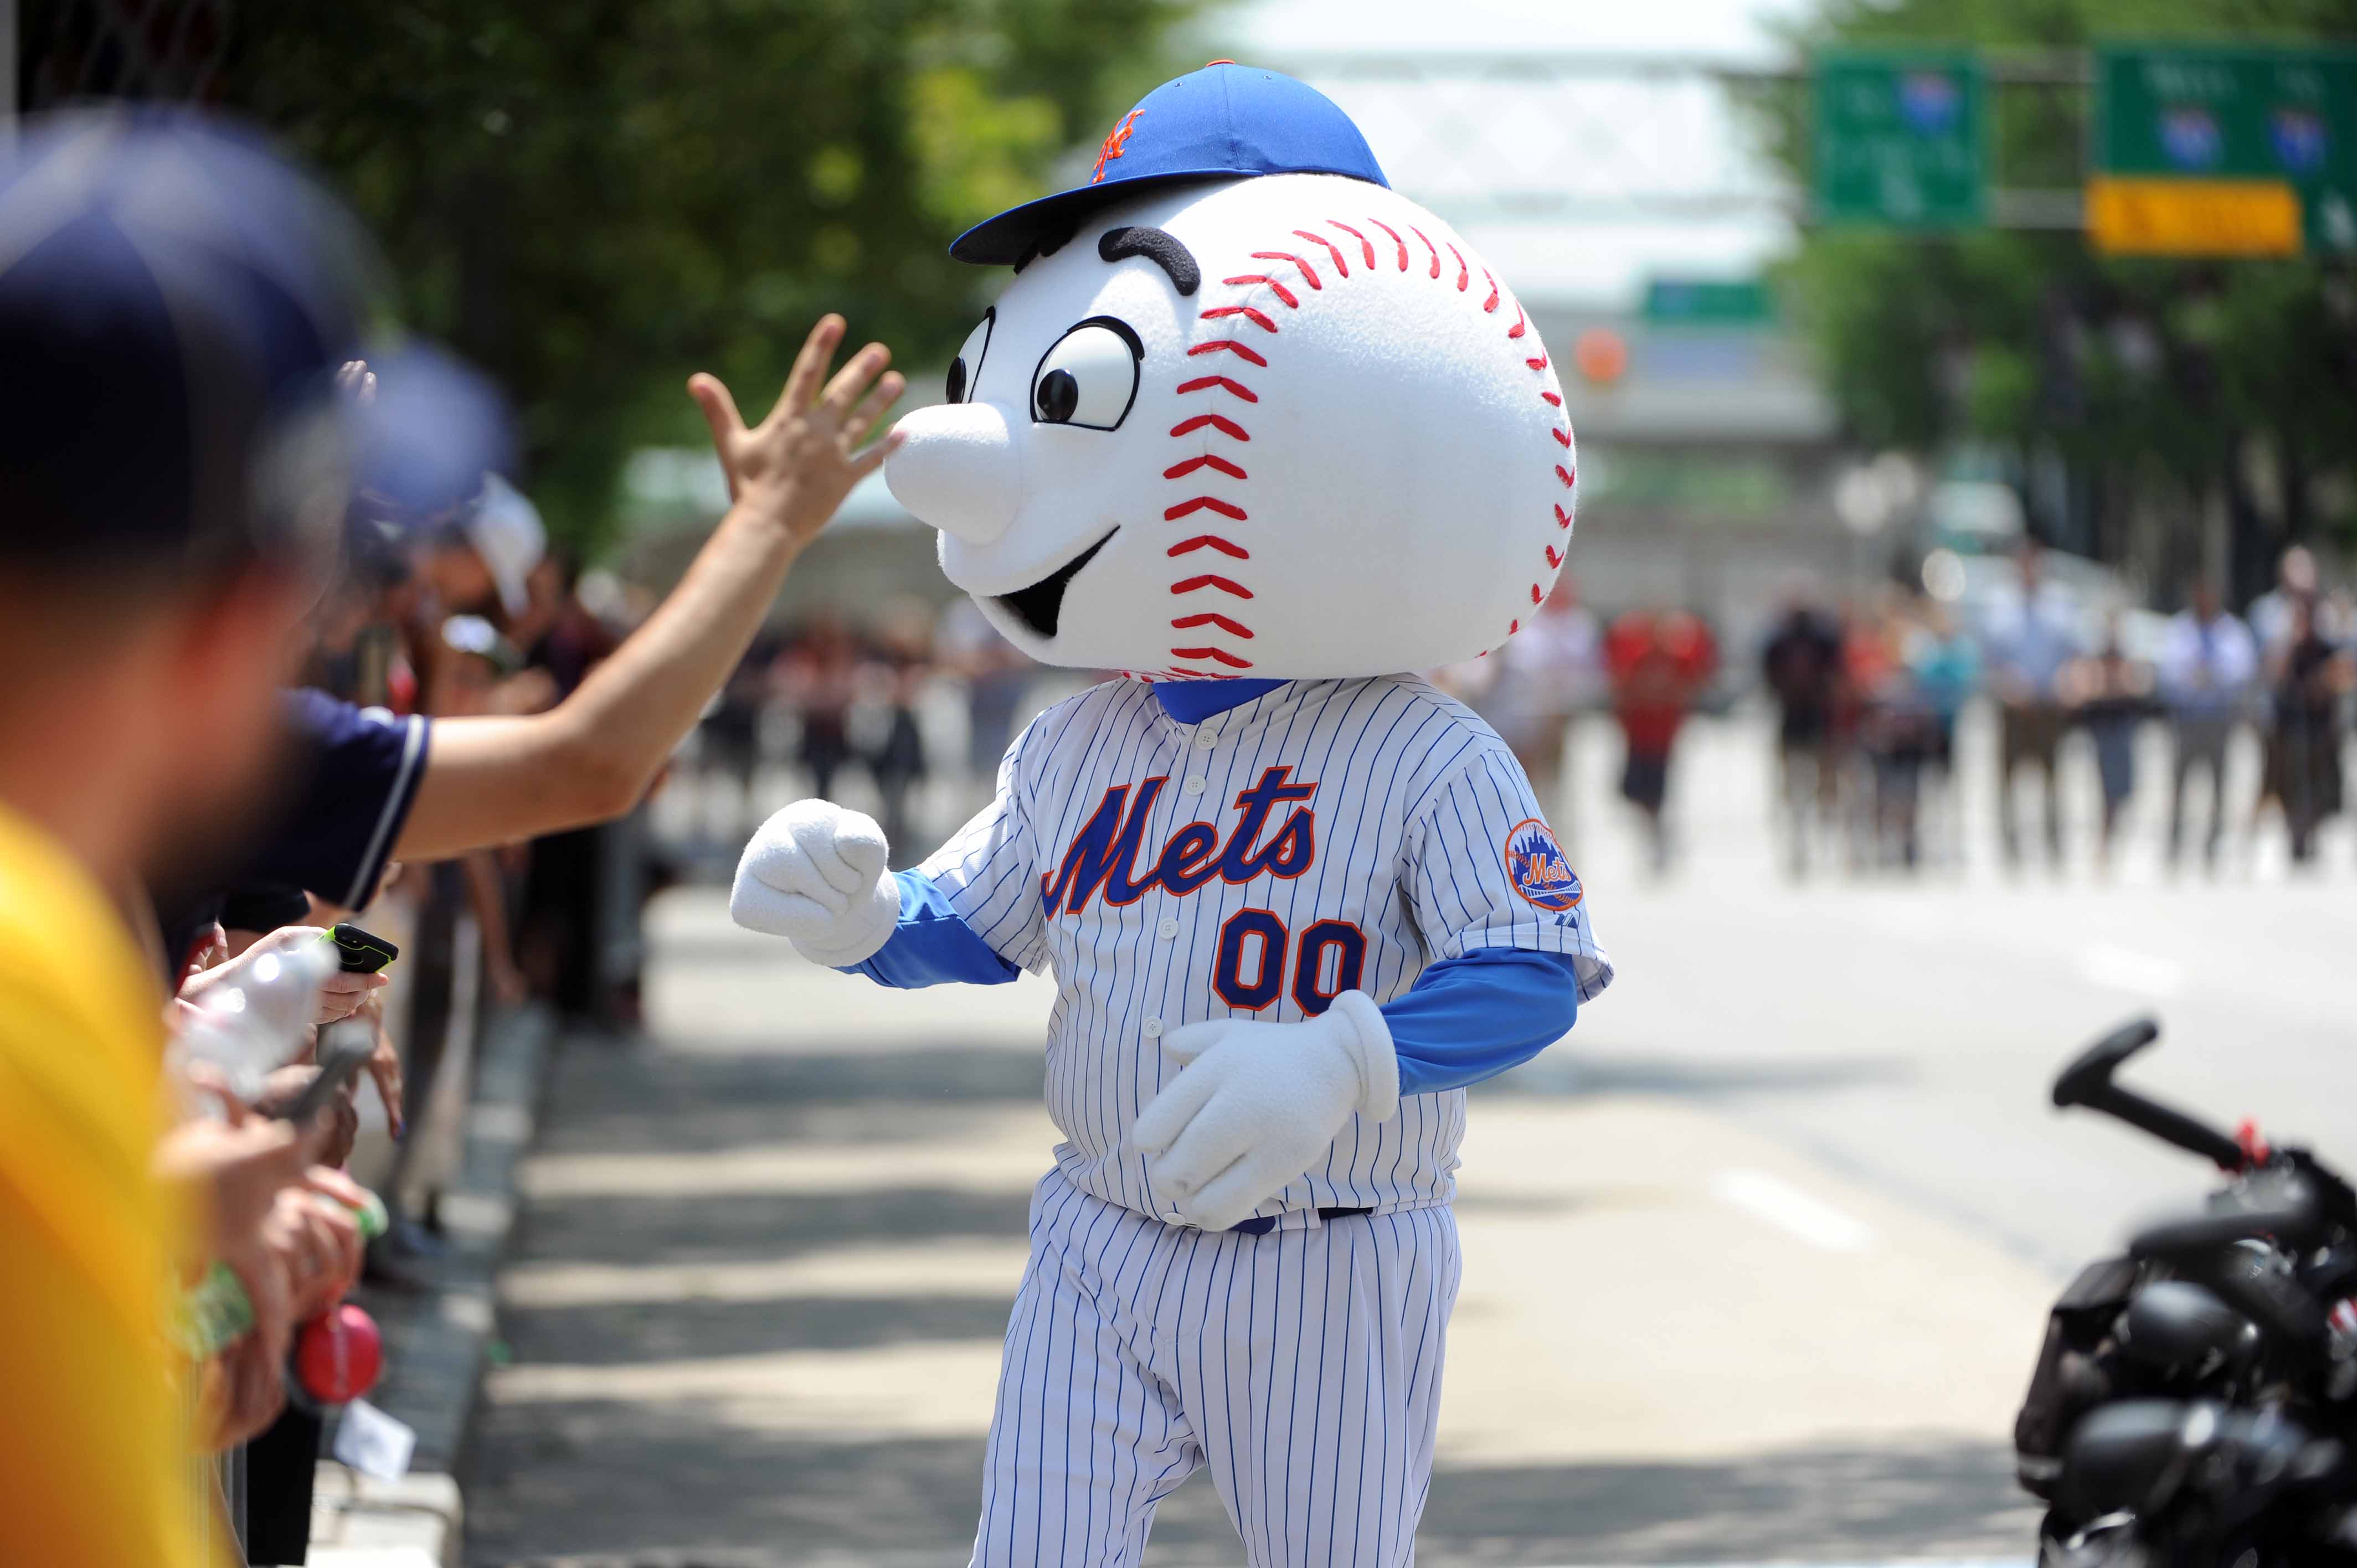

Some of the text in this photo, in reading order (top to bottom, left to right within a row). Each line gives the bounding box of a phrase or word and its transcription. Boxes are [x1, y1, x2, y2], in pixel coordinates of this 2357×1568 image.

[1041, 765, 1318, 921] Mets
[1523, 853, 1572, 886] Mets
[1213, 907, 1367, 1017] 00
